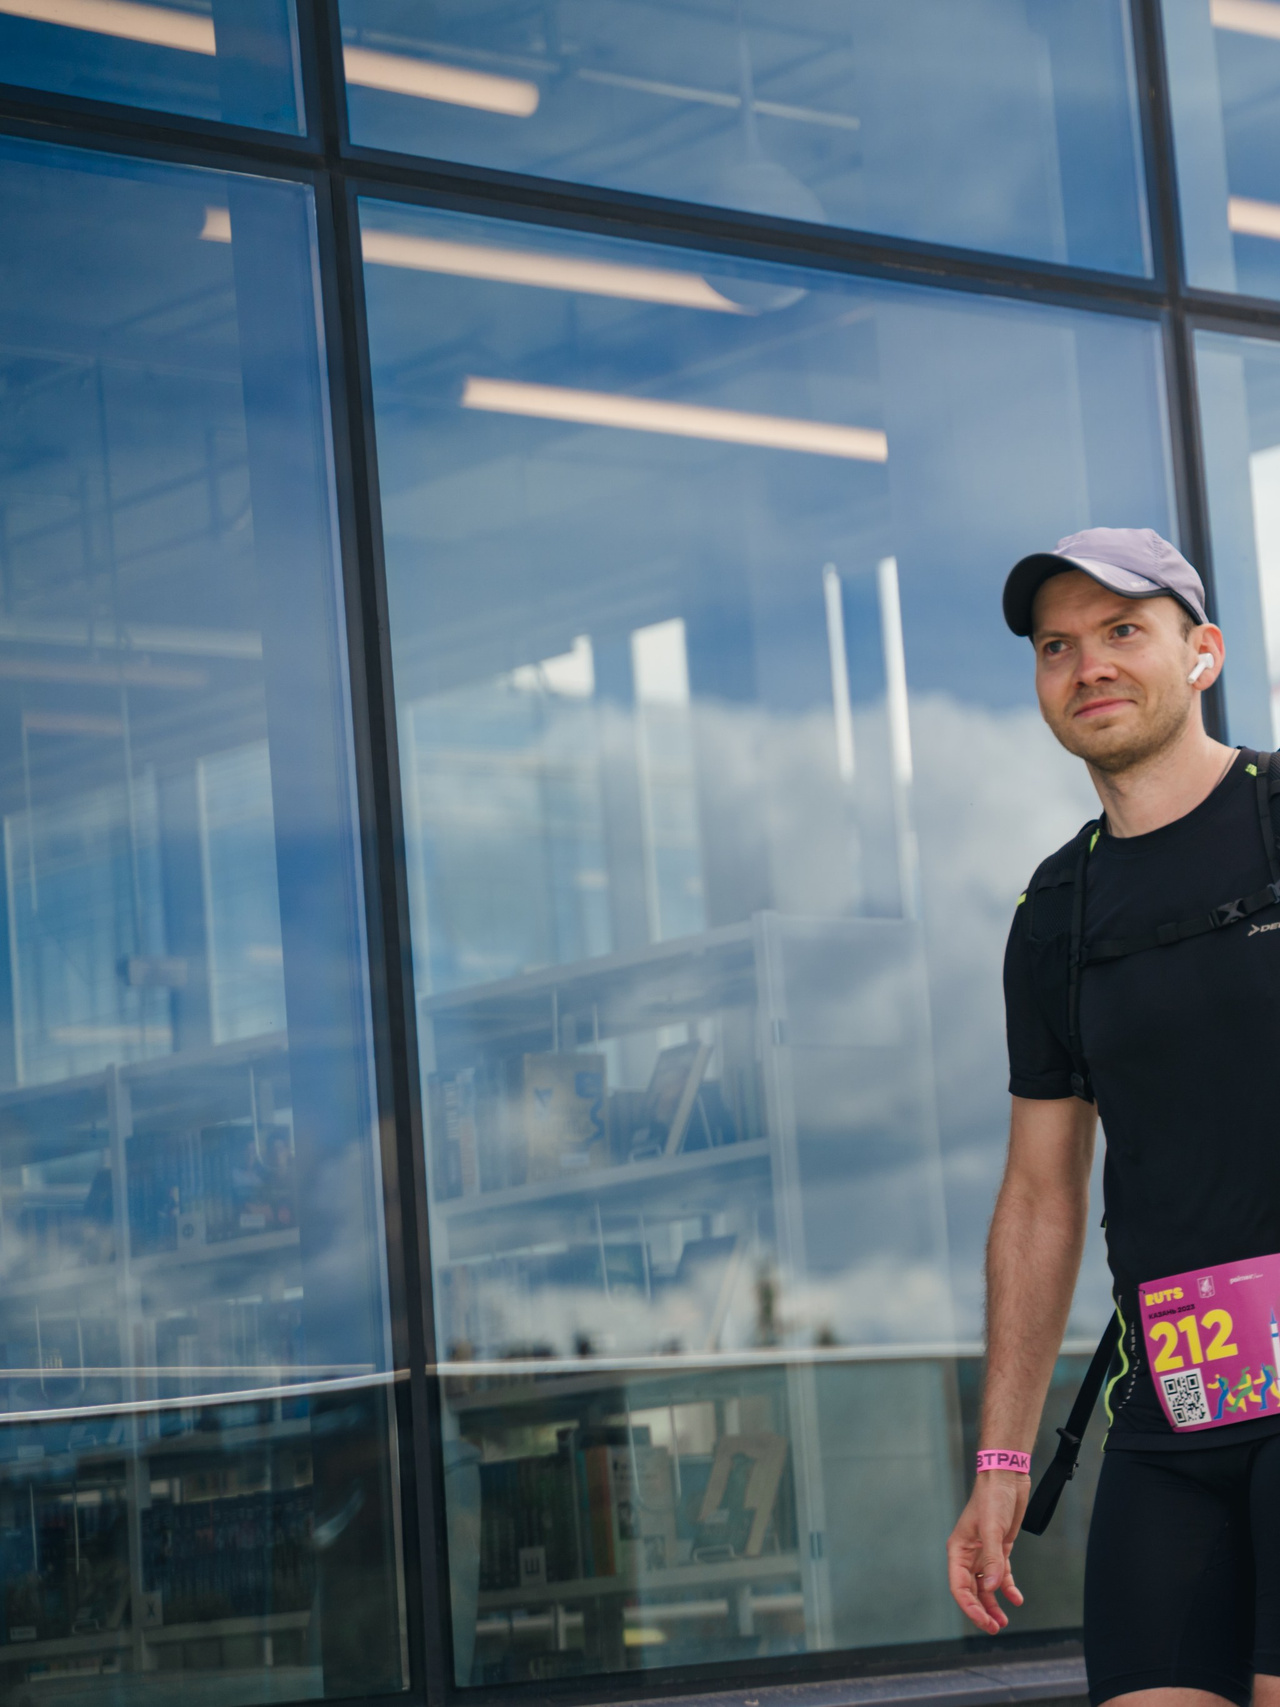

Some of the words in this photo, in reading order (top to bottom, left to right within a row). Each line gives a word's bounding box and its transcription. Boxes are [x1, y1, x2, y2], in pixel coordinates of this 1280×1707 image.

[1144, 1286, 1184, 1307] RUTS
[1148, 1308, 1177, 1320] КАЗАНЬ
[1177, 1303, 1196, 1313] 2023
[1148, 1308, 1238, 1373] 212
